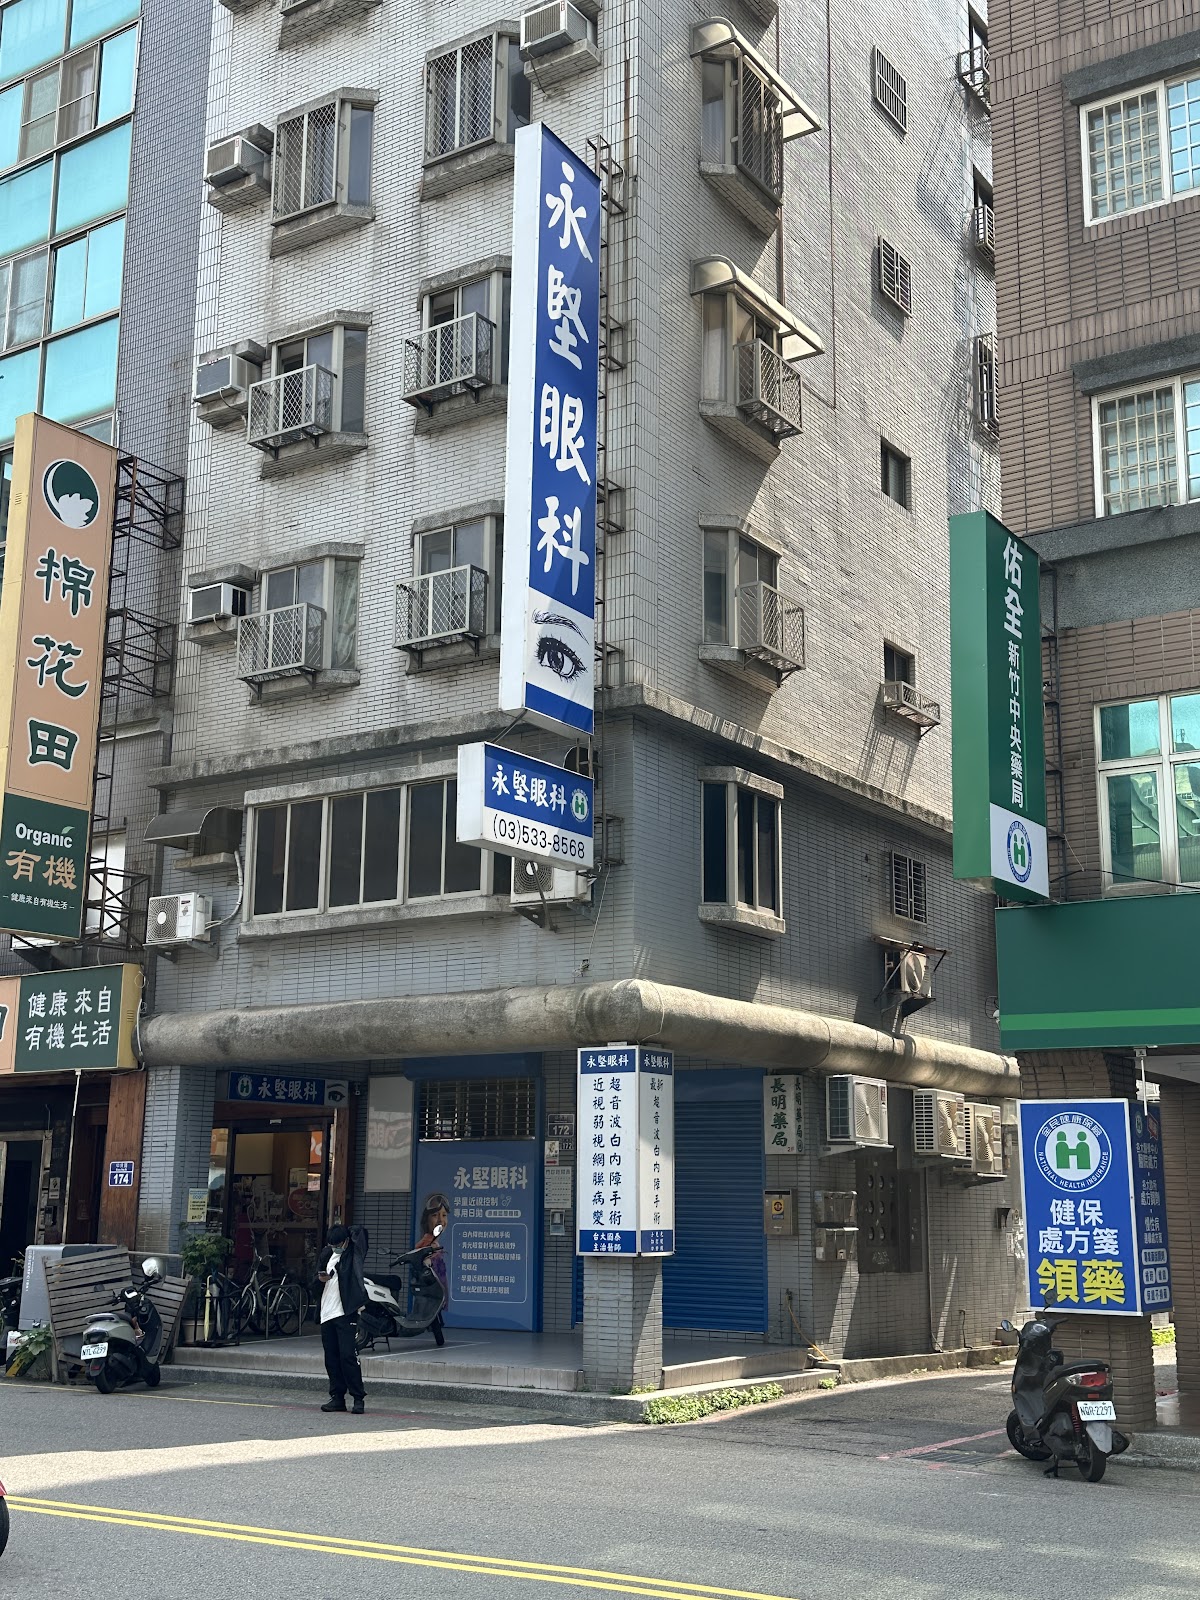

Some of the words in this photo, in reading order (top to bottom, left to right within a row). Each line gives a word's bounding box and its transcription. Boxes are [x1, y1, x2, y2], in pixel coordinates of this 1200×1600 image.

[536, 161, 593, 595] 永堅眼科
[1003, 536, 1025, 640] 佑全
[26, 547, 96, 772] 棉花田
[1008, 641, 1024, 808] 新竹中央藥局
[491, 764, 567, 815] 永堅眼科
[15, 823, 73, 848] Organic
[493, 813, 585, 859] (03)533-8568
[5, 849, 78, 890] 有機
[27, 985, 112, 1019] 健康來自
[25, 1019, 112, 1050] 有機生活
[586, 1053, 629, 1068] 永堅眼科
[258, 1077, 317, 1102] 永堅眼科
[553, 1125, 570, 1135] 172
[770, 1077, 789, 1147] 長明藥局
[592, 1076, 605, 1226] 近視弱視網膜病變
[609, 1076, 622, 1226] 超音波白內障手術
[1038, 1151, 1058, 1183] NATIONAL
[1059, 1179, 1086, 1189] HEALTH
[1086, 1151, 1109, 1185] INSURANCE
[113, 1173, 129, 1185] 174
[453, 1165, 528, 1190] 永堅眼科
[1050, 1198, 1103, 1226] 健保
[1038, 1227, 1120, 1255] 處方箋
[1036, 1257, 1126, 1304] 領藥
